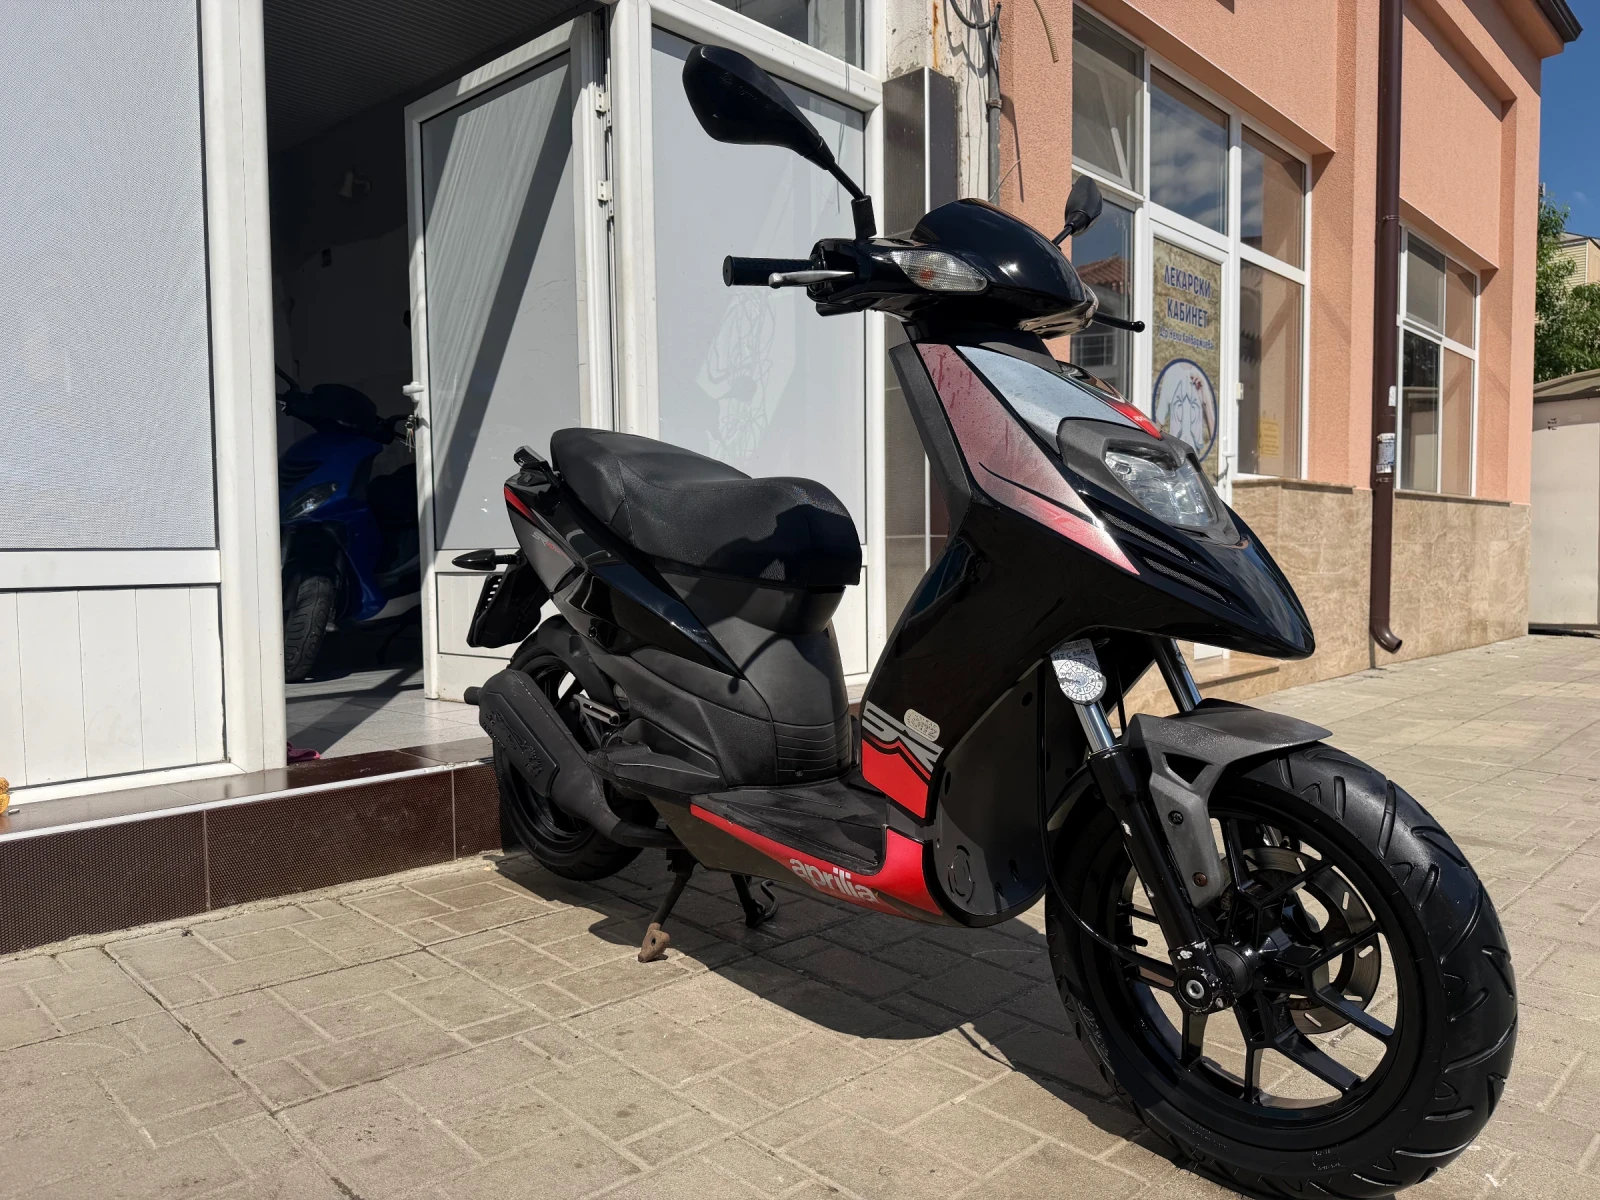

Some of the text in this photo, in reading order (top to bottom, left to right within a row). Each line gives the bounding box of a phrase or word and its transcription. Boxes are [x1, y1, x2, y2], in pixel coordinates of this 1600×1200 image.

[1164, 264, 1211, 298] ЛЕКАРСКИ
[1167, 298, 1208, 329] КАБИНЕТ
[789, 858, 879, 903] aprilia
